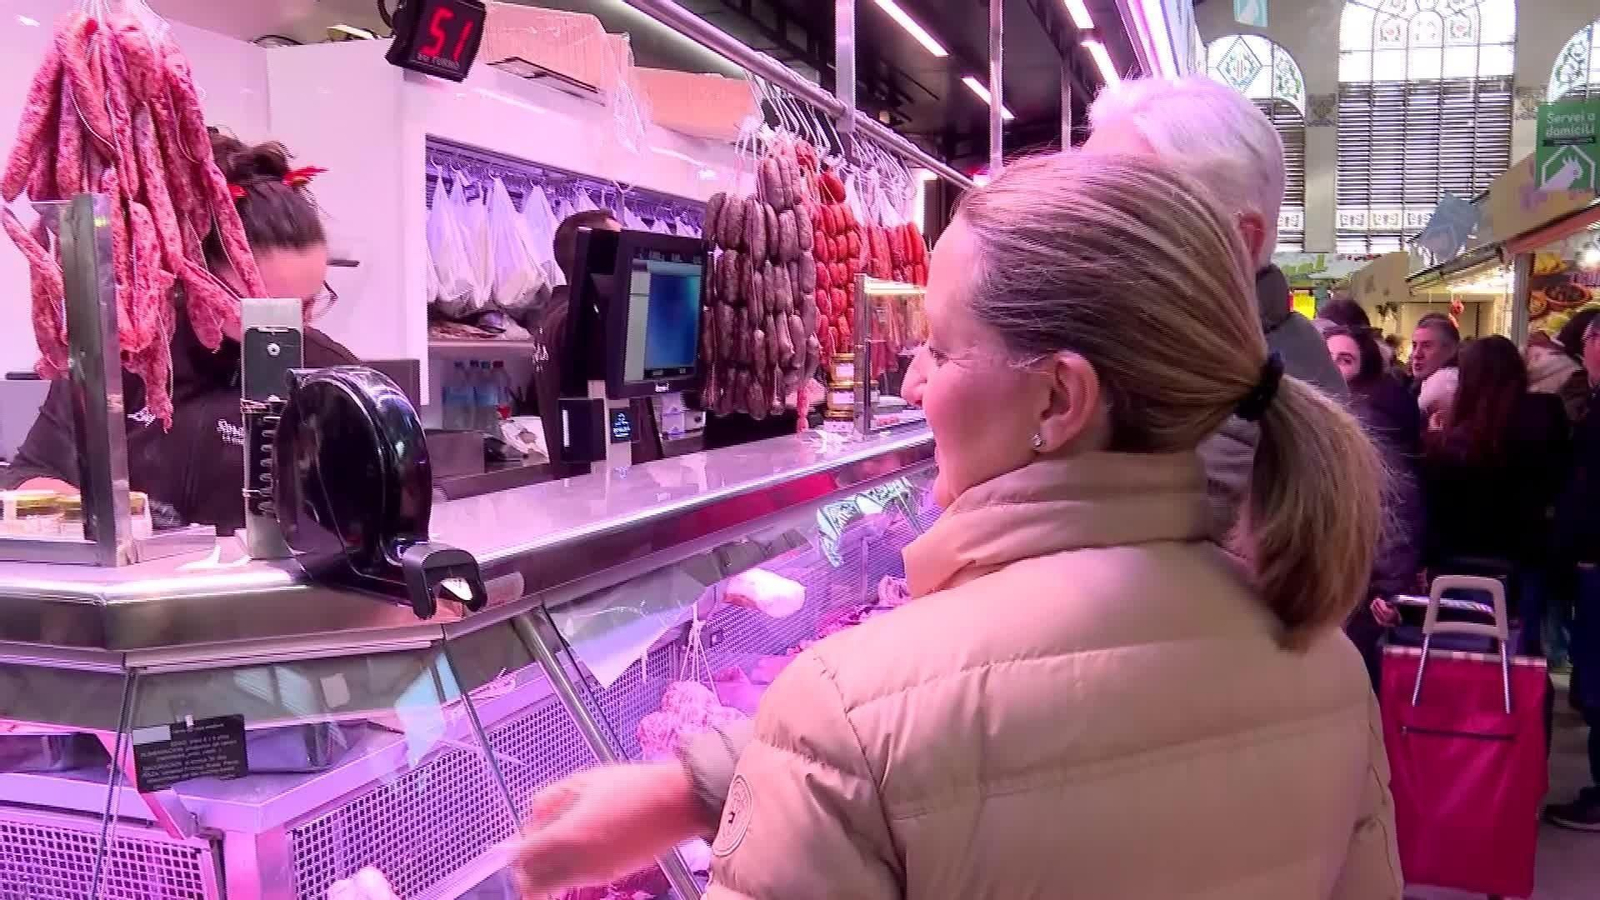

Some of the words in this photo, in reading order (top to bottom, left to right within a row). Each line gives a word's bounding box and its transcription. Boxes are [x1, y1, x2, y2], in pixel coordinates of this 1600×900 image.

[420, 6, 474, 60] 51
[1547, 111, 1585, 124] Servei
[1587, 112, 1596, 121] a
